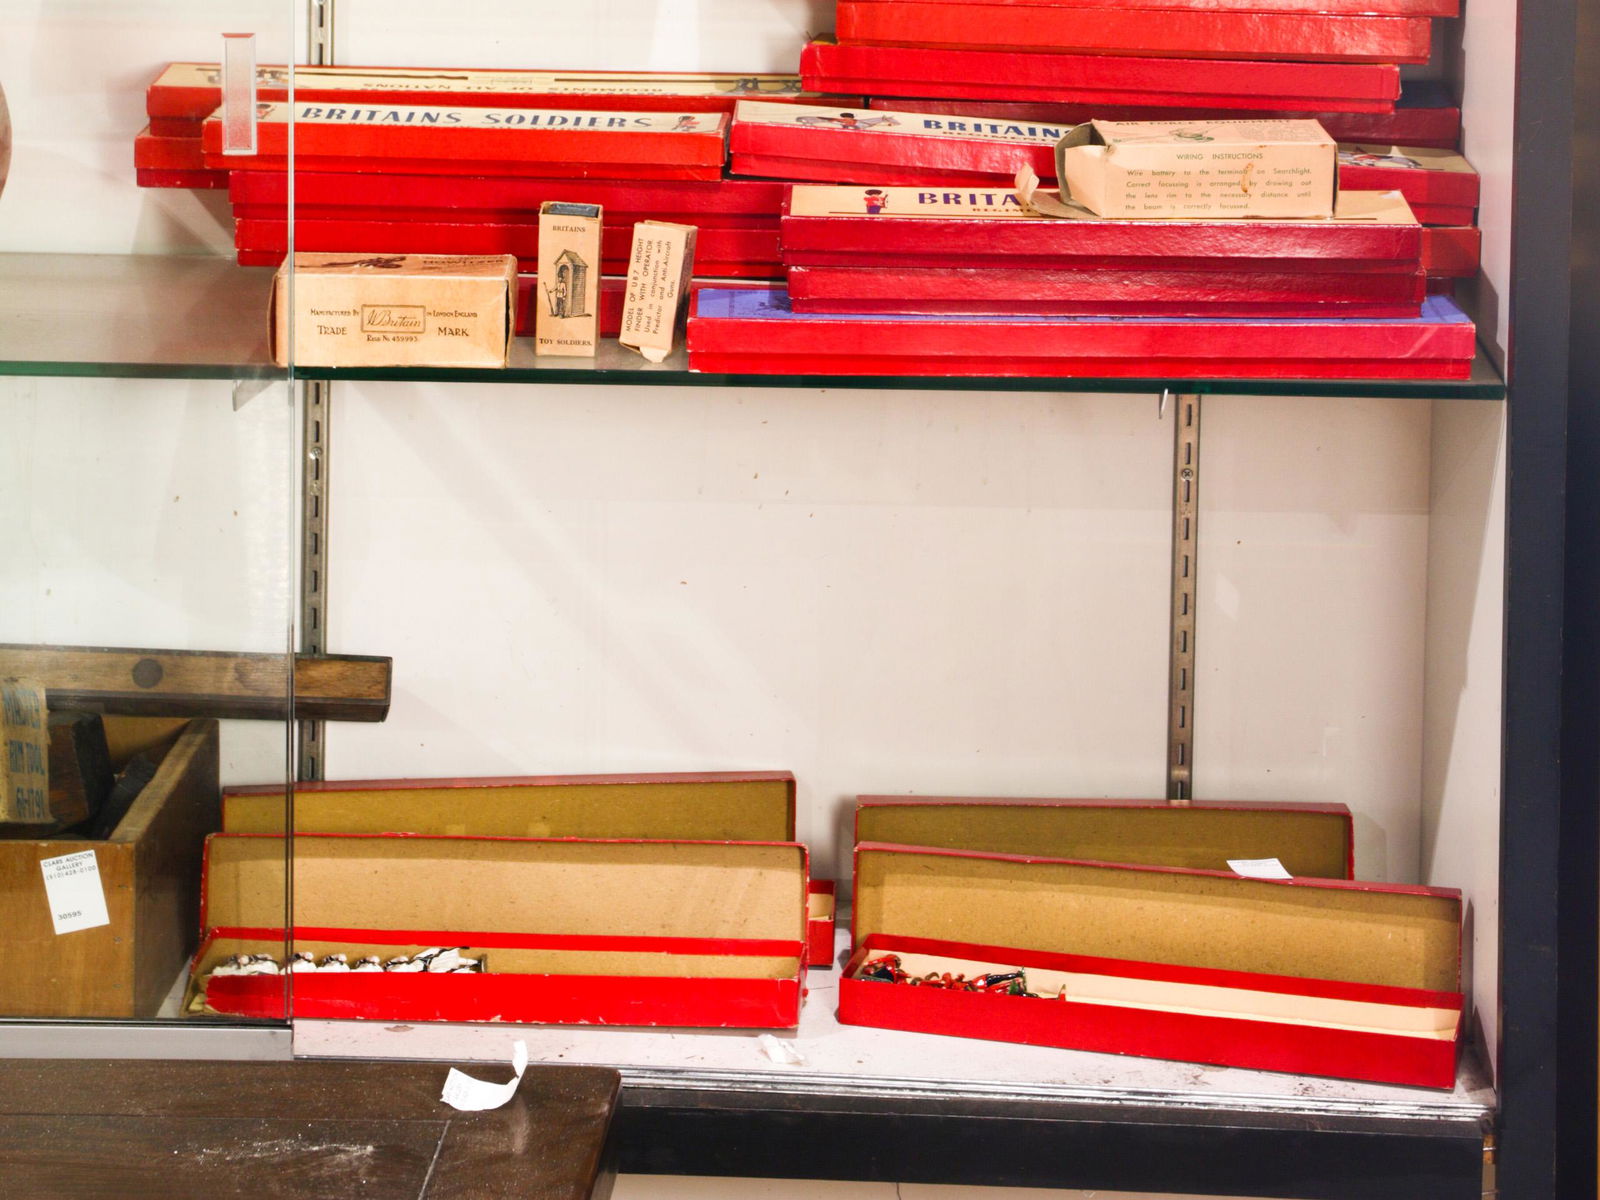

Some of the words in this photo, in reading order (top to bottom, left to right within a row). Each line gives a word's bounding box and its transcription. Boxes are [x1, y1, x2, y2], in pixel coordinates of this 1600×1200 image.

[302, 107, 462, 124] BRITAINS
[481, 112, 653, 128] SOLDIERS
[1212, 152, 1264, 160] INSTRUCTIONS
[1151, 169, 1176, 177] battery
[1158, 180, 1189, 188] focussing
[1209, 180, 1241, 188] arranged
[918, 192, 1024, 206] BRITA
[1183, 202, 1211, 210] correctly
[552, 225, 586, 233] BRITAINS
[635, 238, 644, 263] HEIGHT
[629, 292, 636, 303] OF
[644, 316, 652, 333] Used
[650, 260, 660, 298] conjunction
[626, 307, 635, 332] MODEL
[635, 308, 643, 332] FINDER
[653, 305, 662, 334] Predictor
[317, 325, 348, 336] TRADE
[438, 327, 470, 337] MARK
[539, 337, 554, 345] TOY
[65, 852, 94, 862] AUCTION
[56, 862, 83, 871] GALLERY
[58, 910, 82, 921] 30595
